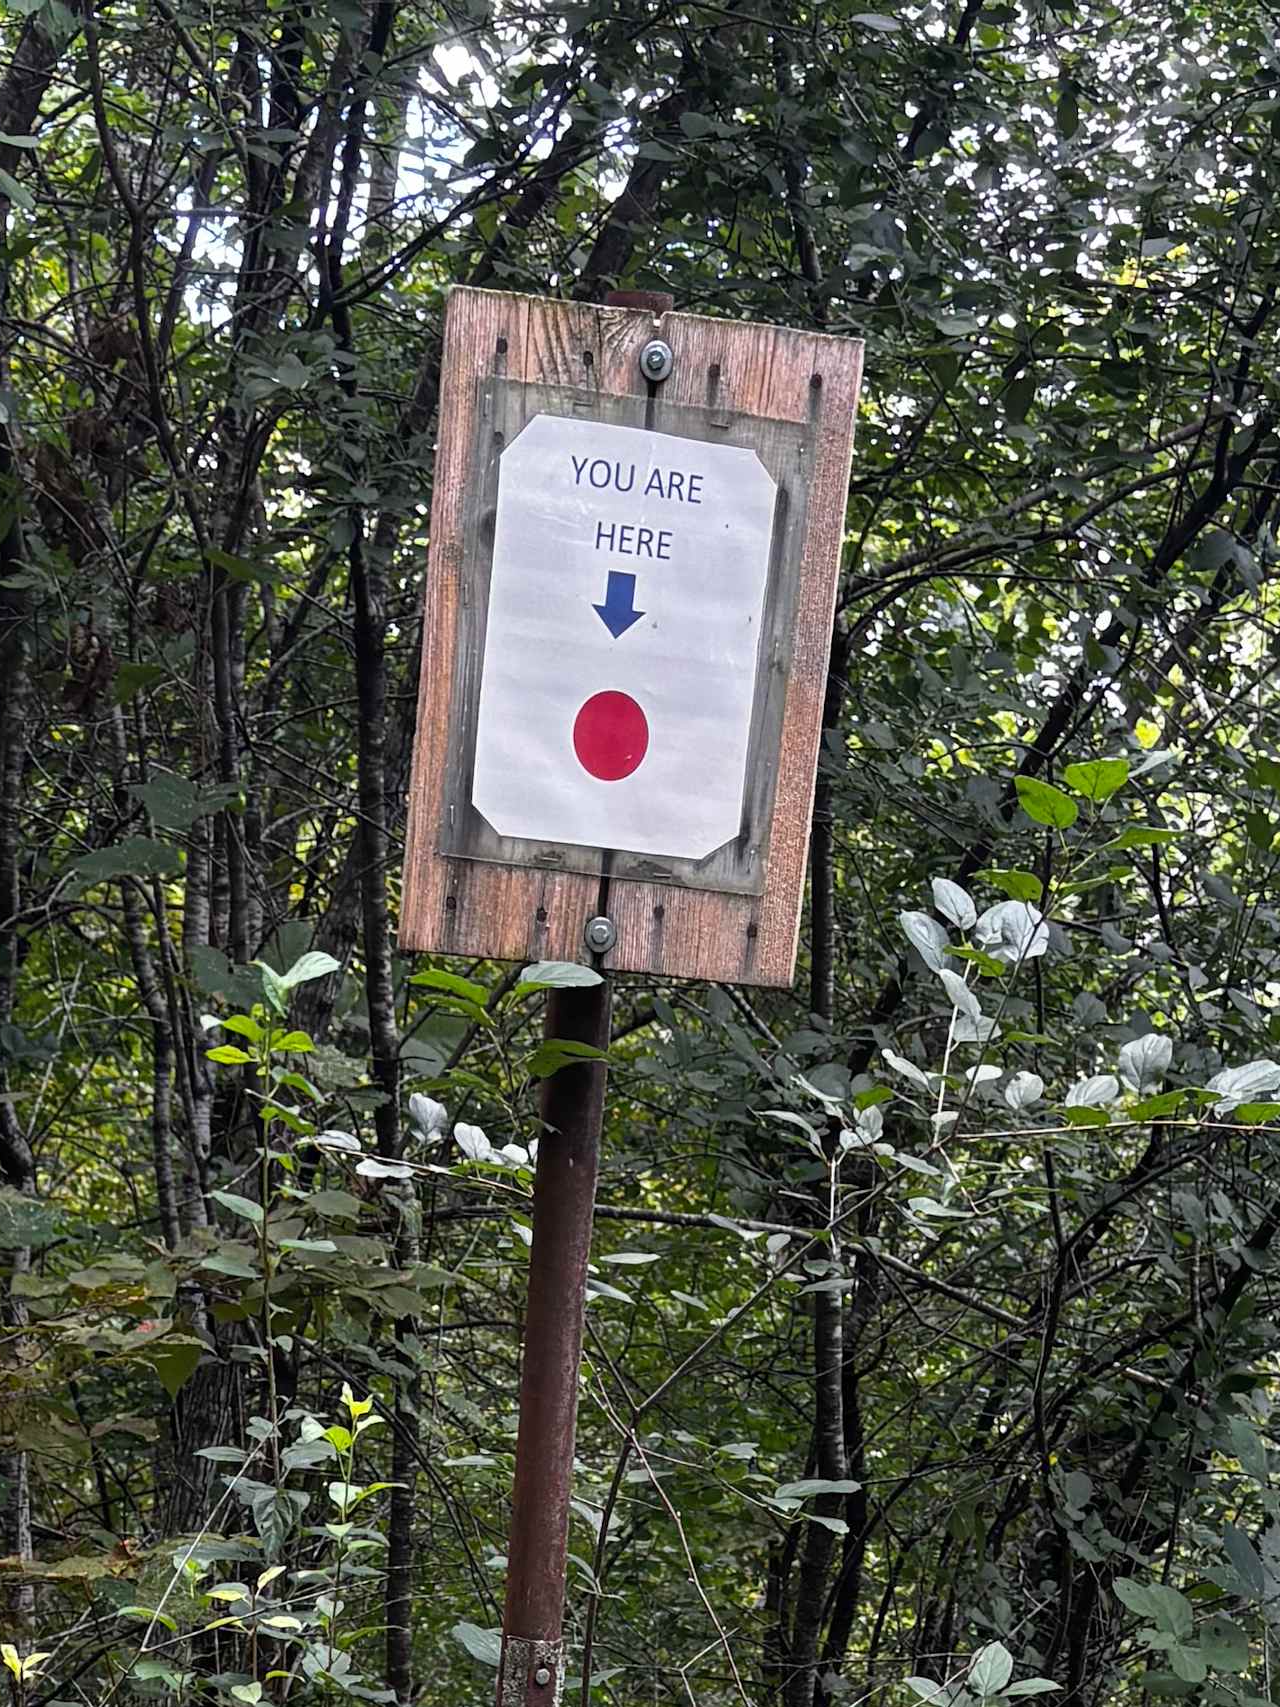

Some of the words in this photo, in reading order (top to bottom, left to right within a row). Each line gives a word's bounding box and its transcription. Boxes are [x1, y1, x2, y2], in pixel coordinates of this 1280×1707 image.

[571, 455, 635, 492] YOU
[644, 468, 704, 504] ARE
[595, 521, 673, 560] HERE
